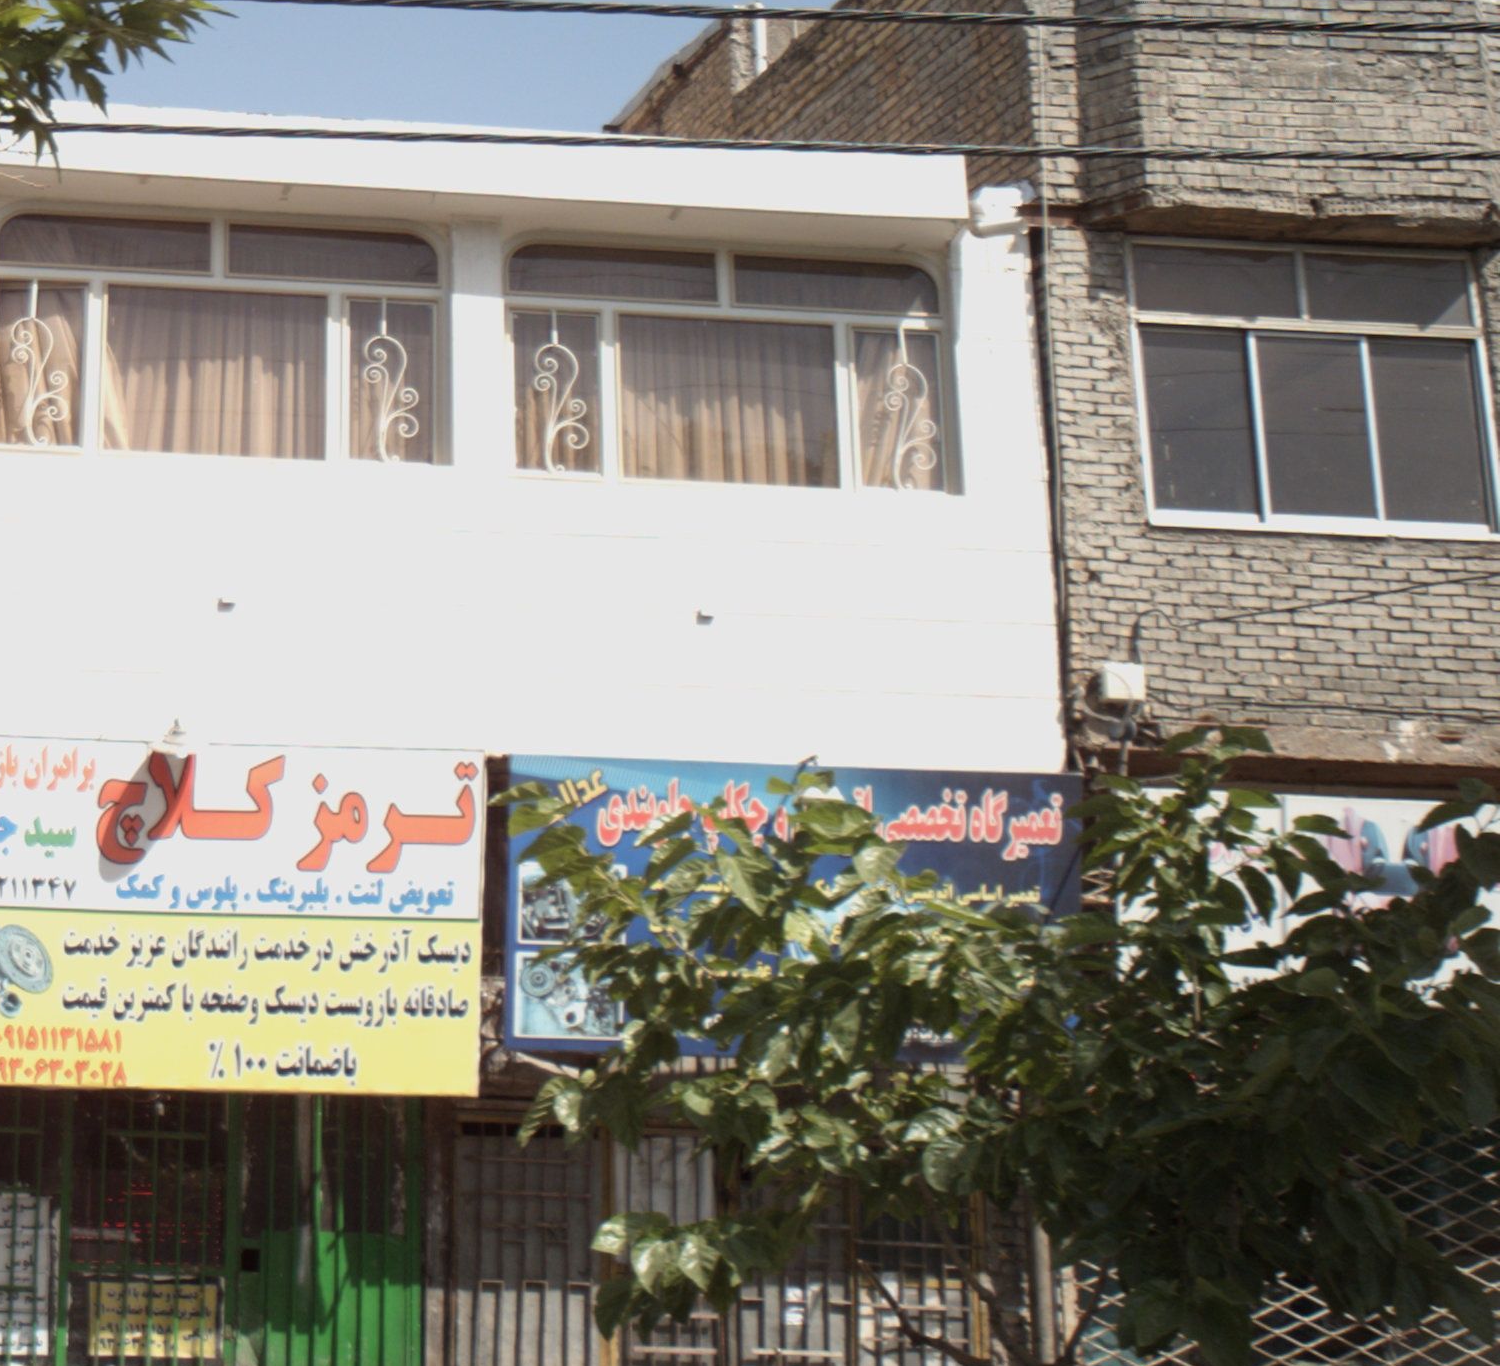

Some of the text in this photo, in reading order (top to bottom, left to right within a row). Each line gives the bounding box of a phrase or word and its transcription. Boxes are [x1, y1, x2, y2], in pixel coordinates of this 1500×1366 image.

[23, 745, 96, 793] برادران
[96, 750, 479, 873] ترمز کلاچ
[23, 816, 77, 858] سید
[115, 874, 166, 901] کمک
[168, 886, 182, 909] و
[185, 875, 238, 912] پلوس
[256, 877, 329, 911] بلبرینگ
[349, 877, 384, 906] لنت
[389, 881, 455, 915] تعویض
[62, 926, 121, 956] خدمت
[125, 930, 167, 969] عزیز
[171, 928, 248, 971] رانندگان
[417, 934, 472, 973] دیسک
[61, 976, 109, 1019] قیمت
[112, 981, 177, 1022] کمترین
[181, 982, 195, 1022] با
[264, 984, 320, 1024] دیسک
[403, 984, 470, 1019] صادقانه
